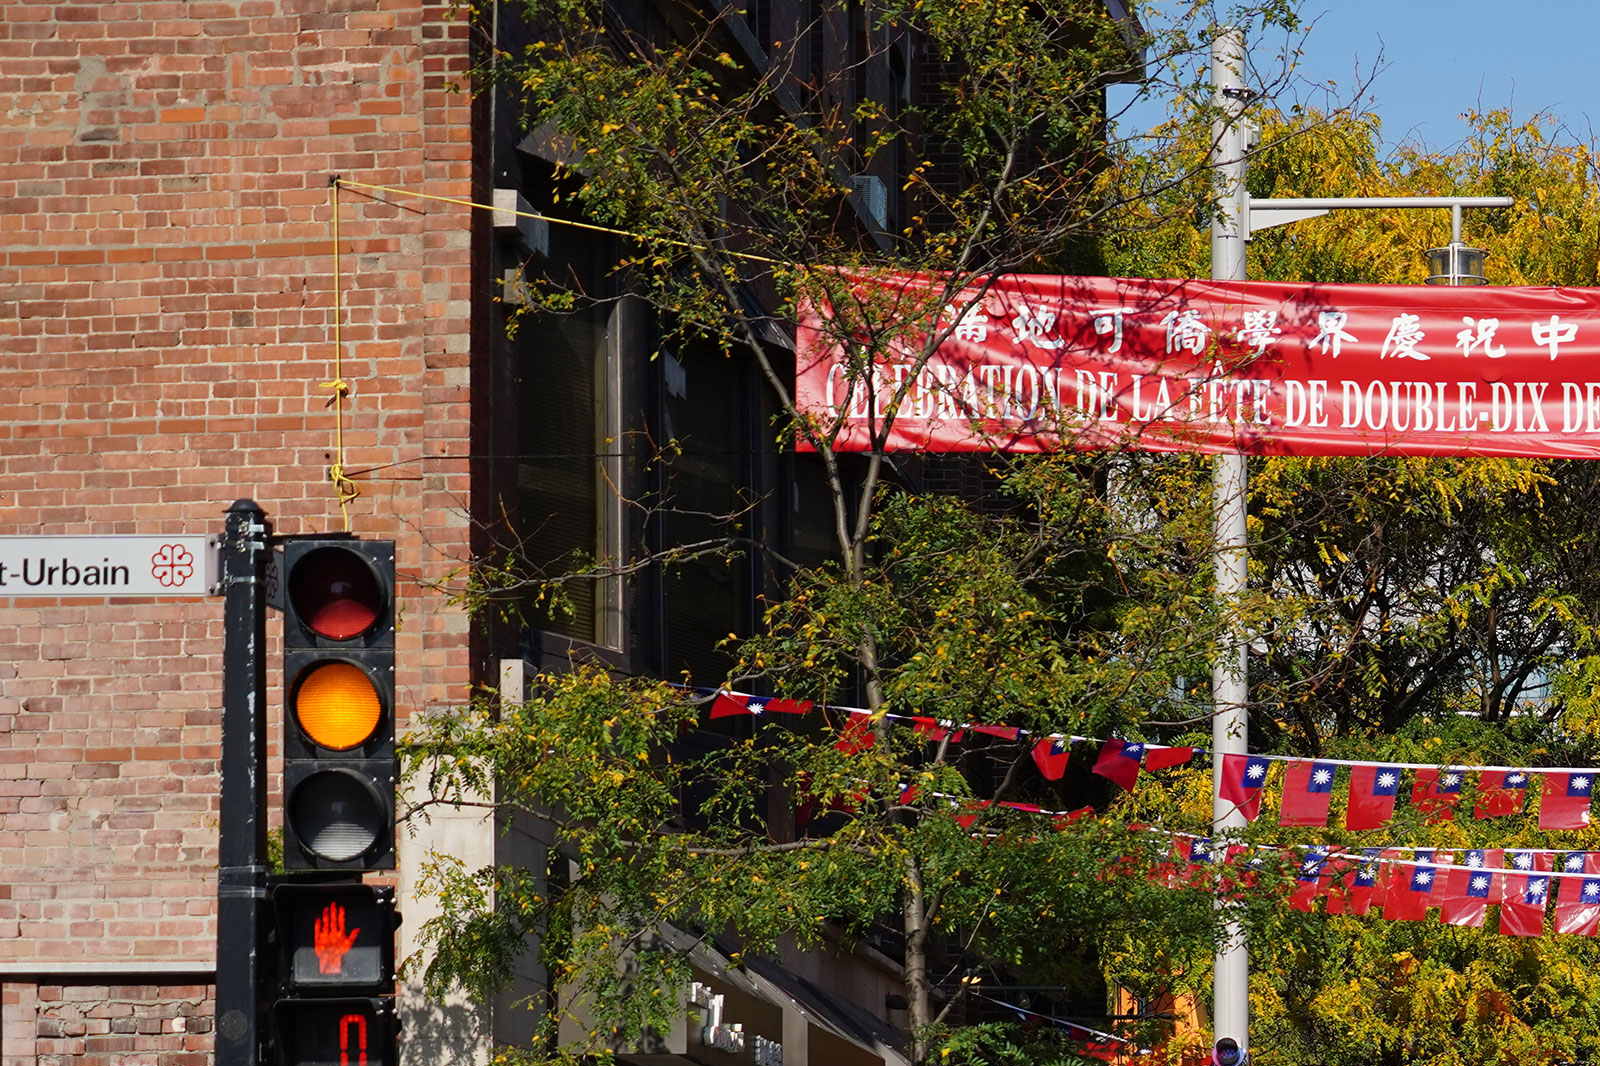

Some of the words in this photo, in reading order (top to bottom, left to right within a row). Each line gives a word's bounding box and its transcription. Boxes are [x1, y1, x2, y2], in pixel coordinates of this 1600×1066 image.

[1075, 369, 1119, 423] DE
[1130, 374, 1175, 423] LA
[1189, 360, 1272, 426] FÊTE
[1285, 379, 1328, 428] DE
[1340, 380, 1549, 433] DOUBLE-DIX
